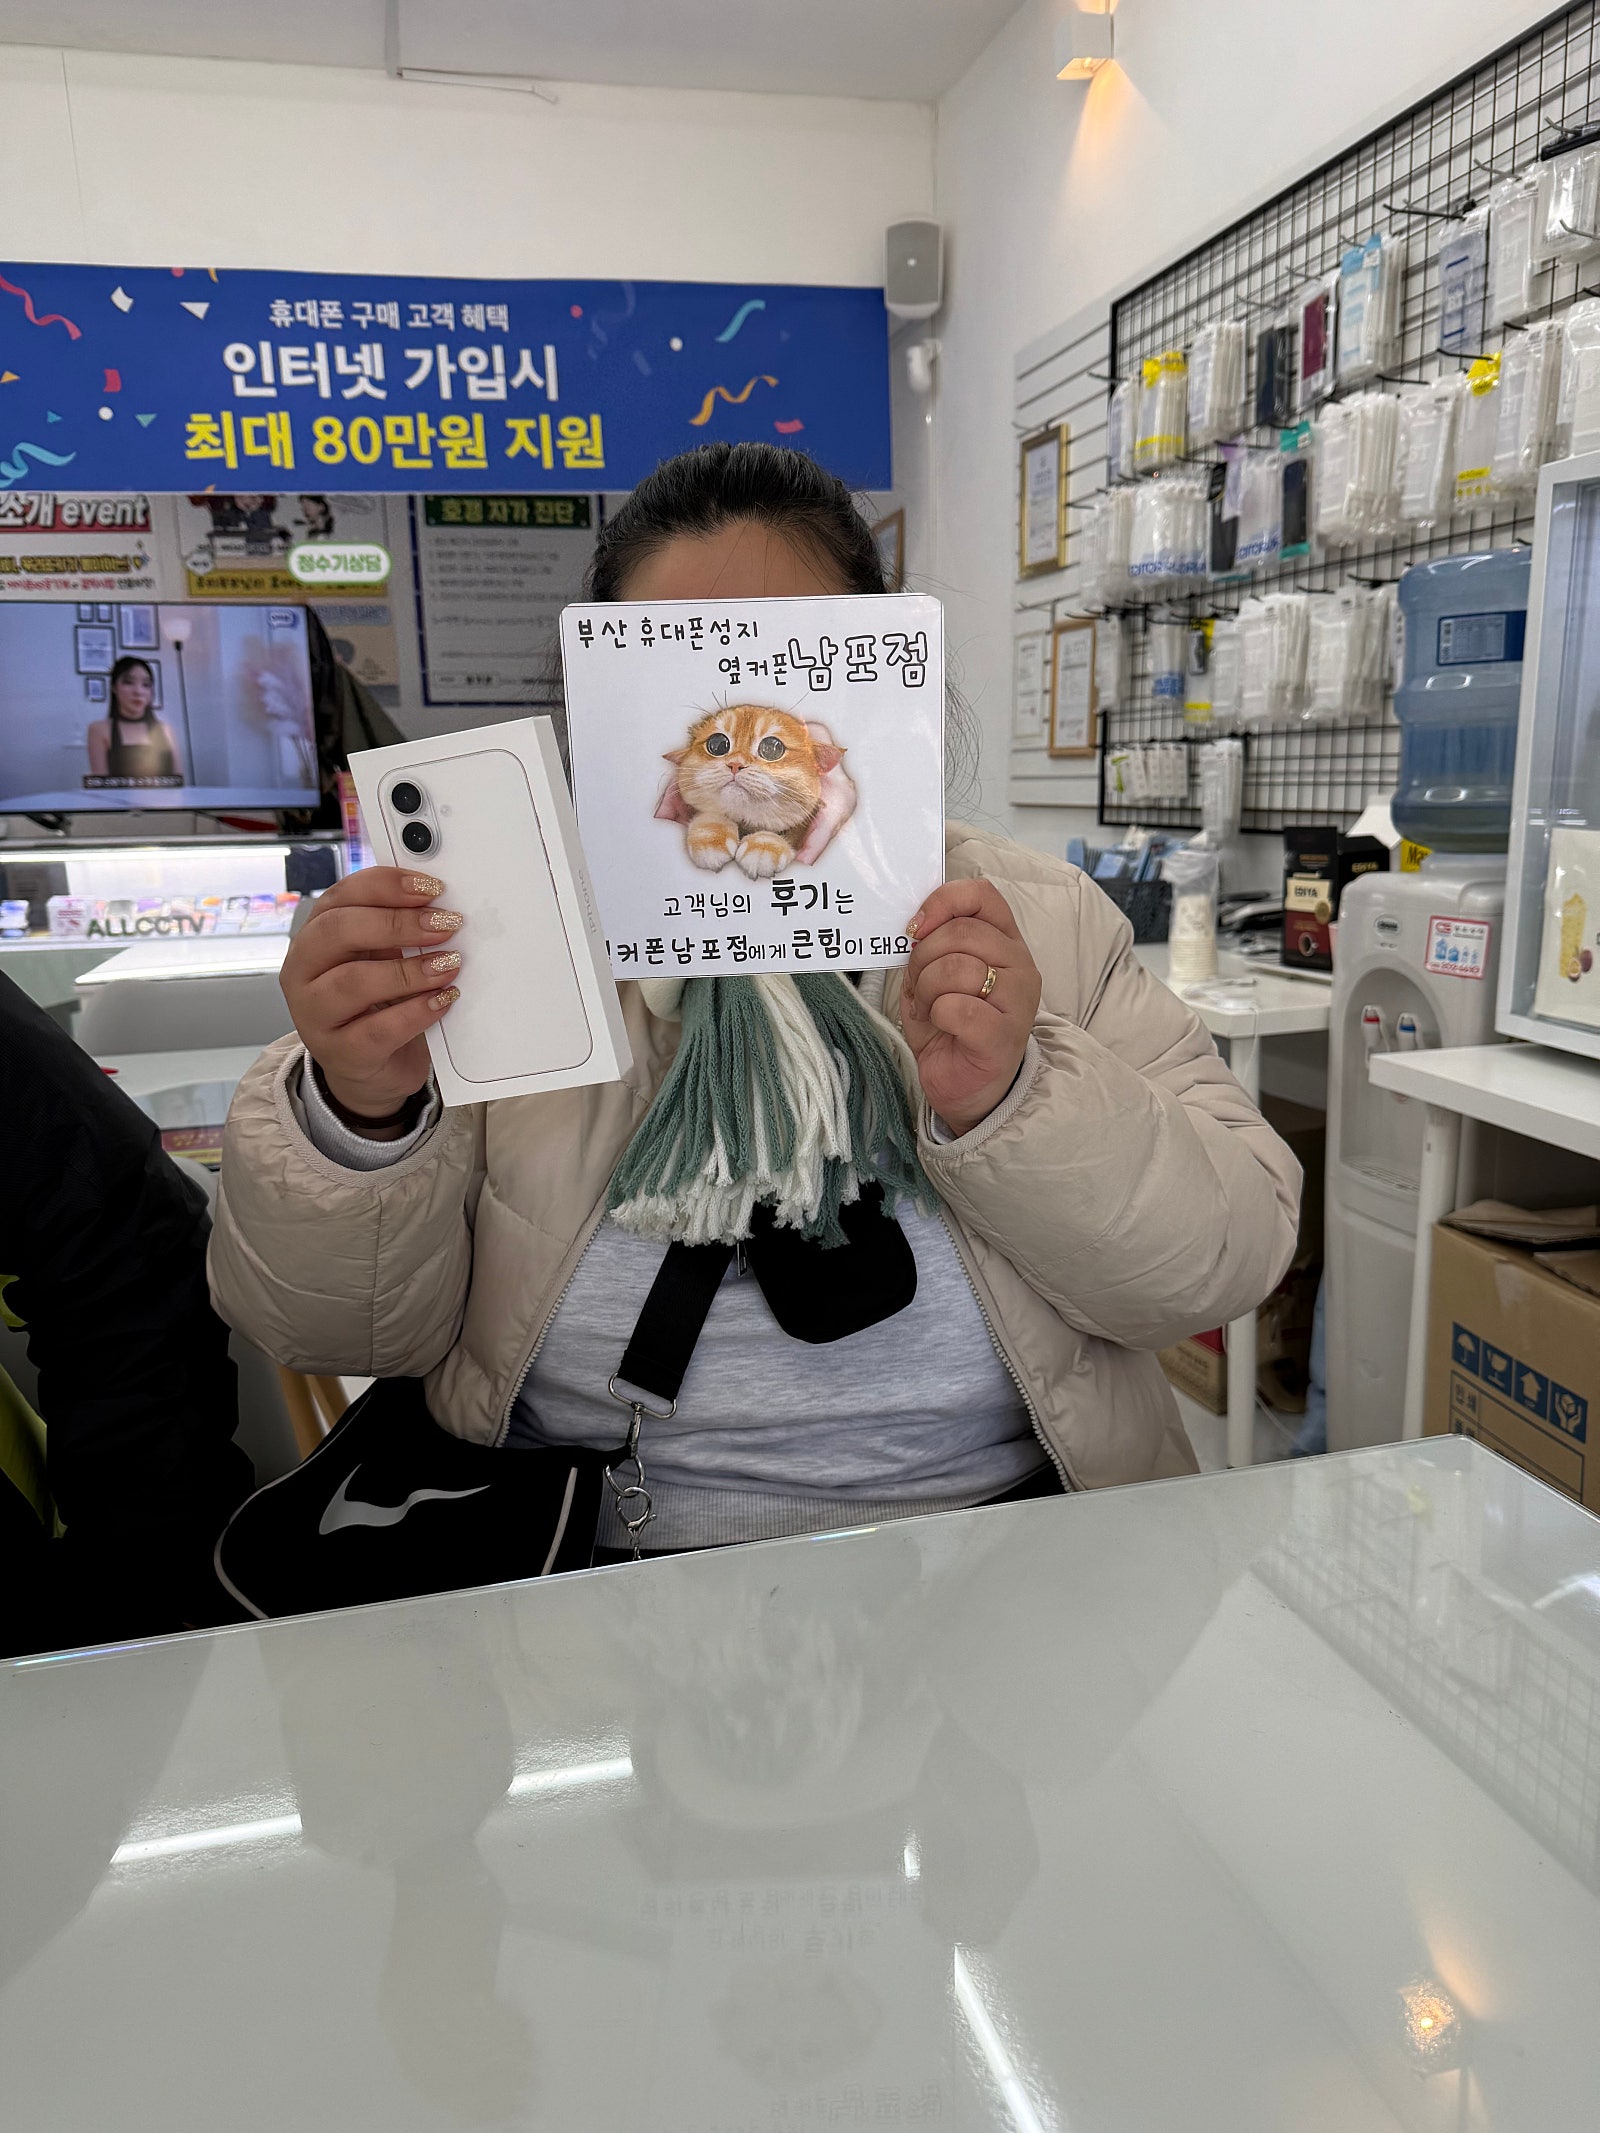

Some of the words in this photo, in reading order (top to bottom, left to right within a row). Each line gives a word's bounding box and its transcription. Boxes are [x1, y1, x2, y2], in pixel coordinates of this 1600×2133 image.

[269, 299, 344, 329] 휴대폰
[351, 301, 400, 330] 구매
[408, 303, 455, 331] 고객
[462, 304, 509, 332] 혜택
[223, 341, 387, 400] 인터넷
[404, 344, 558, 401] 가입시
[185, 410, 295, 470] 최대
[312, 412, 488, 469] 80만원
[506, 414, 605, 469] 지원
[0, 492, 55, 528] 소개
[61, 494, 149, 527] event
[487, 500, 528, 523] 자가
[296, 554, 382, 573] 정수기상담
[578, 618, 628, 649] 부산
[640, 616, 758, 651] 휴대폰성지
[1406, 845, 1427, 865] Ma
[663, 892, 751, 919] 고객님의
[770, 878, 855, 916] 후기는
[1294, 886, 1319, 898] EDIYA
[605, 934, 787, 966] 커폰남포점에게
[869, 935, 911, 955] 돼요
